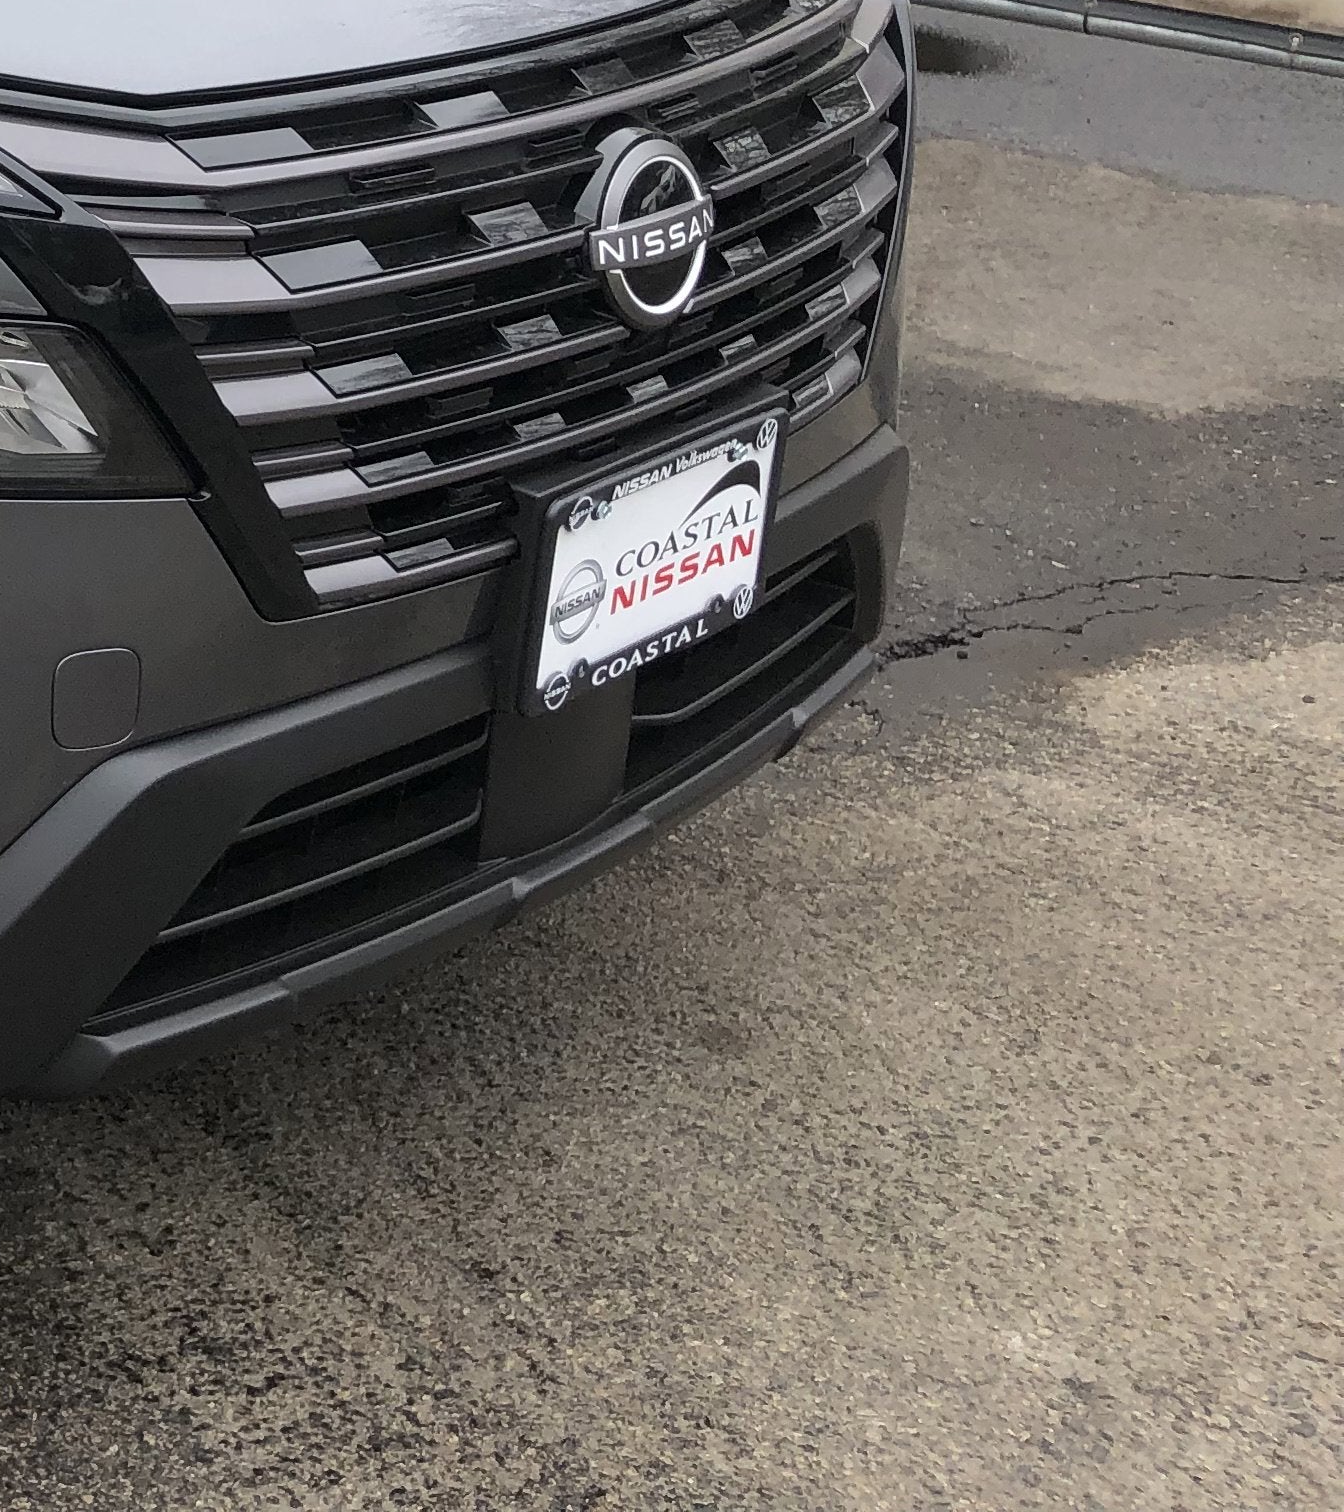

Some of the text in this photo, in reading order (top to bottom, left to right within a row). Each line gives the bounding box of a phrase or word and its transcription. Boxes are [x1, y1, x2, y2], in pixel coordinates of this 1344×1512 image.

[598, 209, 714, 265] NISSAN
[612, 464, 672, 500] NISSAN
[615, 499, 758, 577] COASTAL
[554, 586, 601, 618] NISSAN
[610, 529, 755, 615] NISSAN
[591, 618, 708, 686] COASTAL
